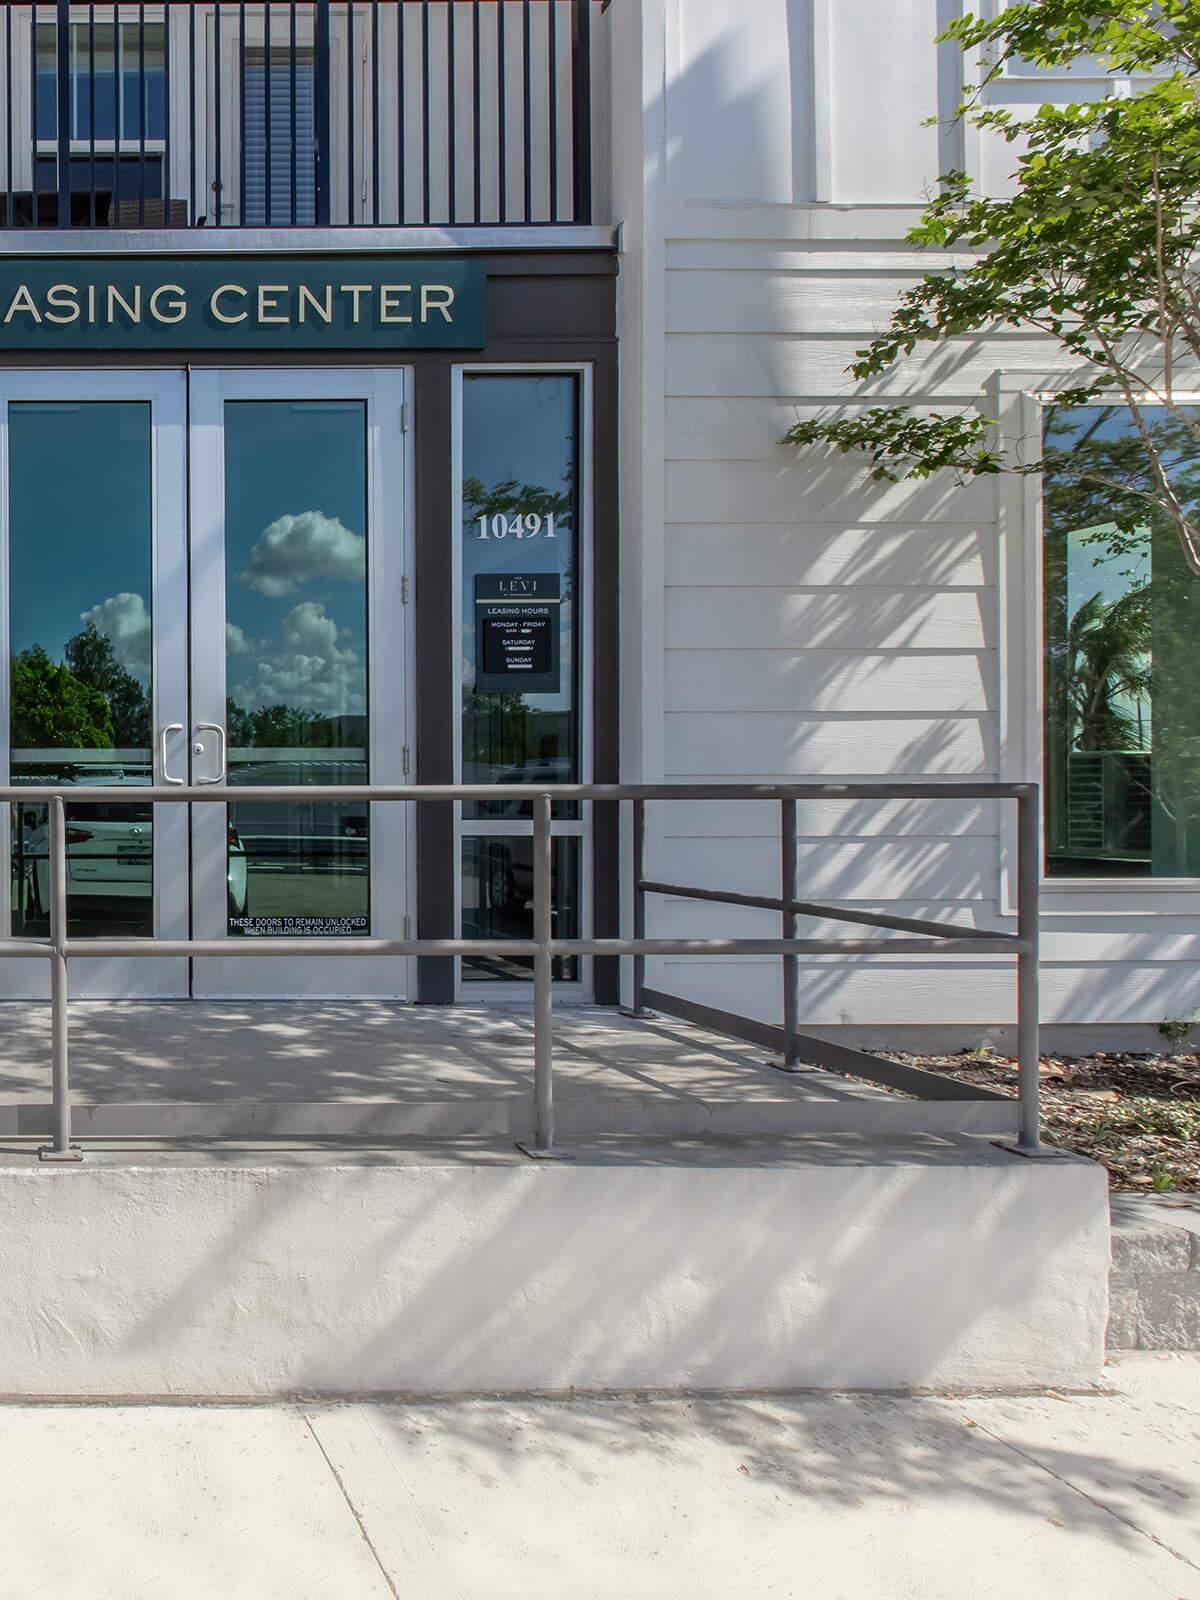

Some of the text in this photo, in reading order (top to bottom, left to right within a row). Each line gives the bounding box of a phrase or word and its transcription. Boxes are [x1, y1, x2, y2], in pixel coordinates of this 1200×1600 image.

[210, 284, 456, 324] CENTER
[477, 512, 557, 539] 10491
[499, 580, 537, 591] LEVI
[487, 607, 549, 615] LEASING HOURS
[229, 918, 367, 927] THESE DOORS TO REMAIN UNLOCKED
[243, 926, 352, 935] WHEN BUILDING IS OCCUPIED
